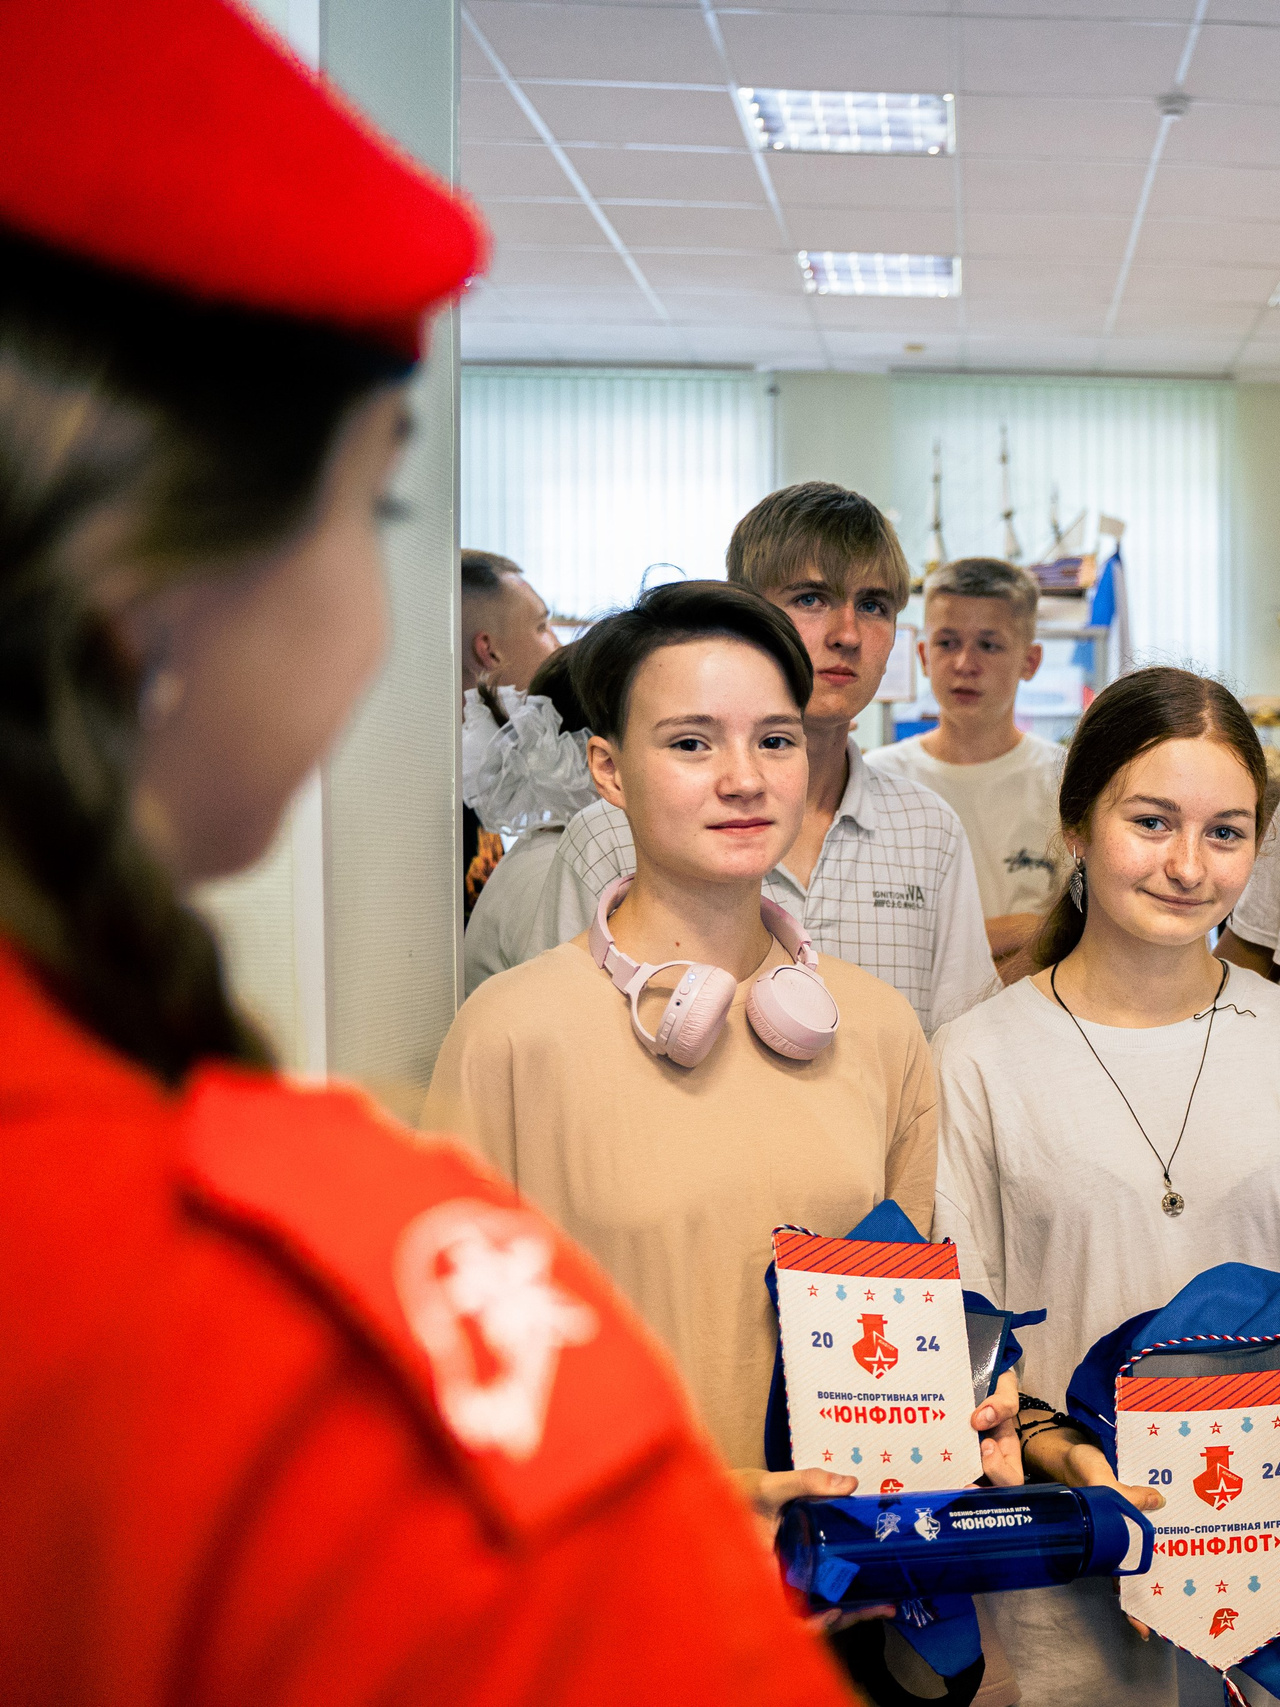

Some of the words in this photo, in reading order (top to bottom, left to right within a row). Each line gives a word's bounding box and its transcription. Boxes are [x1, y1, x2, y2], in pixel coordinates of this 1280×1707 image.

[811, 1331, 834, 1348] 20
[916, 1335, 940, 1352] 24
[817, 1391, 918, 1402] ВОЕННО-СПОРТИВНАЯ
[921, 1393, 945, 1402] ИГРА
[819, 1405, 946, 1424] «ЮНФЛОТ»
[1148, 1469, 1173, 1485] 20
[951, 1514, 1033, 1531] «ЮНФЛОТ»
